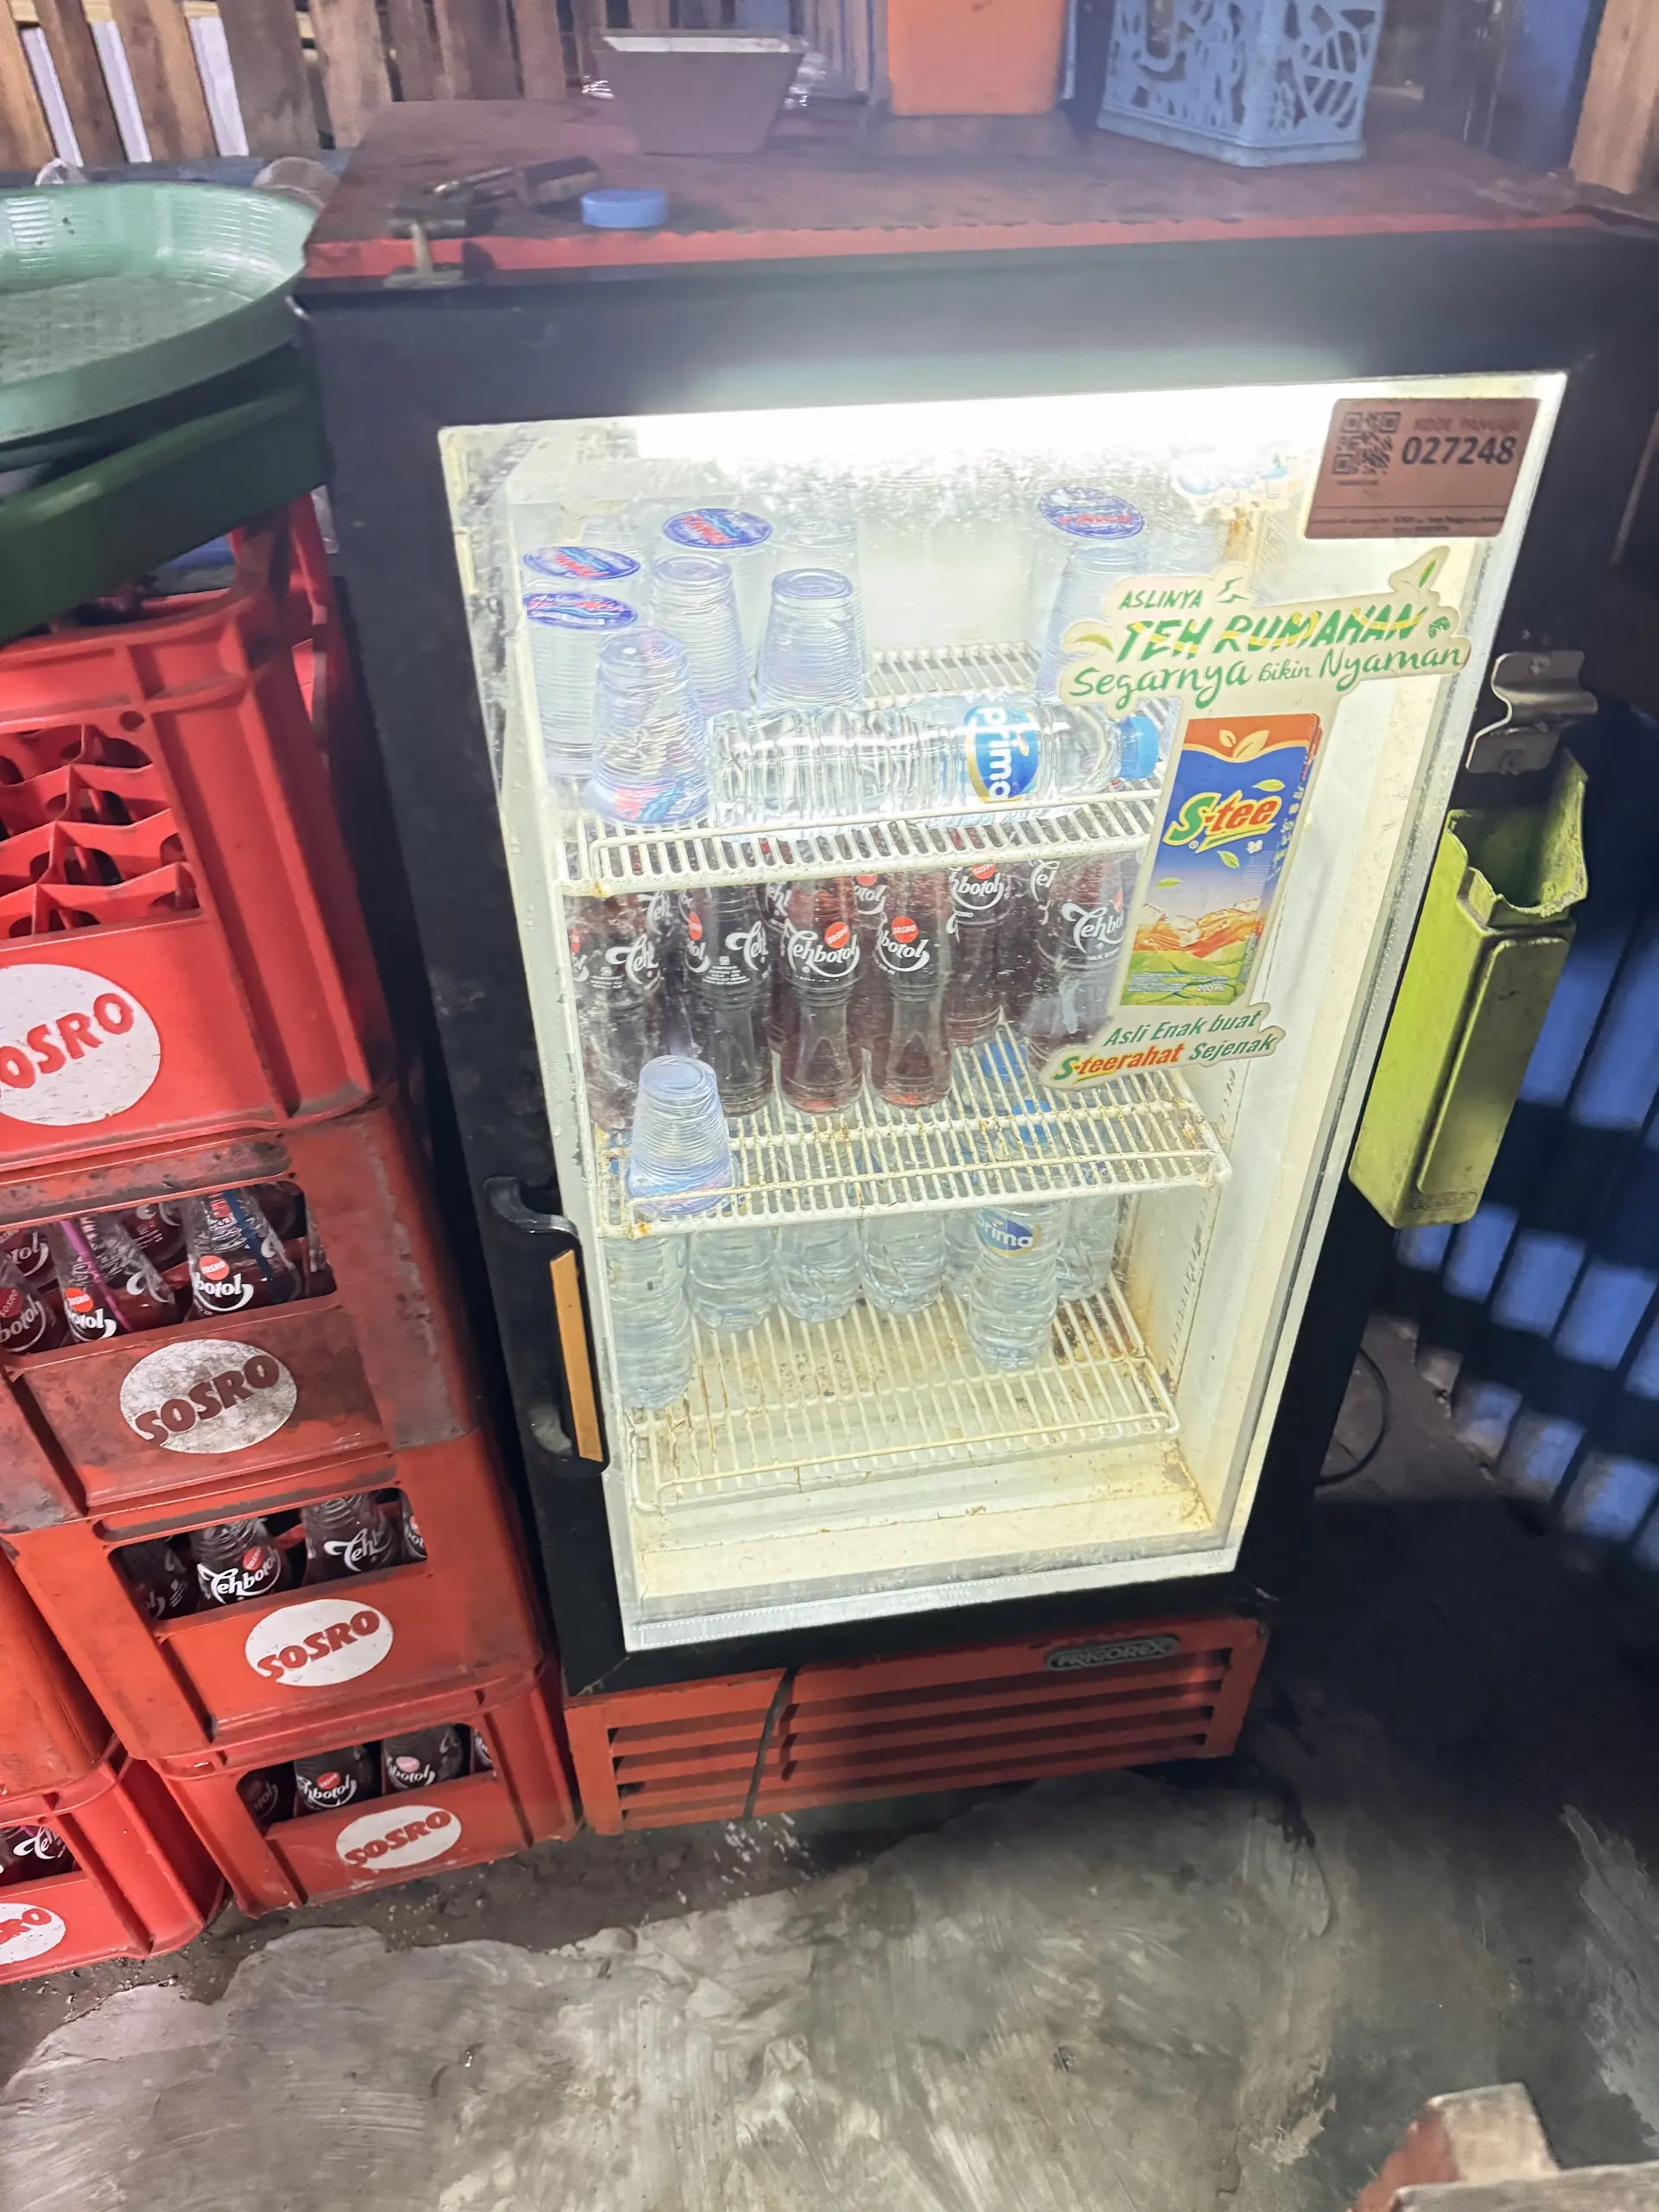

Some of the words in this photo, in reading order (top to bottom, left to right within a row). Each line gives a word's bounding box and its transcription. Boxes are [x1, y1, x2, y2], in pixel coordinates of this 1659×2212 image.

[1401, 435, 1518, 466] 027248
[1118, 589, 1205, 610] ASLINYA
[1116, 615, 1214, 663] TEH
[1212, 603, 1428, 653] RUMAHAN
[1069, 660, 1253, 710] Segarnya
[1258, 658, 1313, 682] bikin
[1319, 647, 1465, 692] Nyaman
[1163, 790, 1282, 852] S-tee
[0, 992, 135, 1089] OSRO
[1052, 1043, 1185, 1082] S-teerahat
[1188, 1033, 1278, 1061] Sejenak
[1103, 1024, 1151, 1046] Asli
[1151, 1016, 1208, 1041] Enak
[1207, 1010, 1262, 1033] buat
[136, 1353, 282, 1446] SOSRO
[257, 1610, 381, 1681] SOSRO
[345, 1810, 453, 1866] SOSRO
